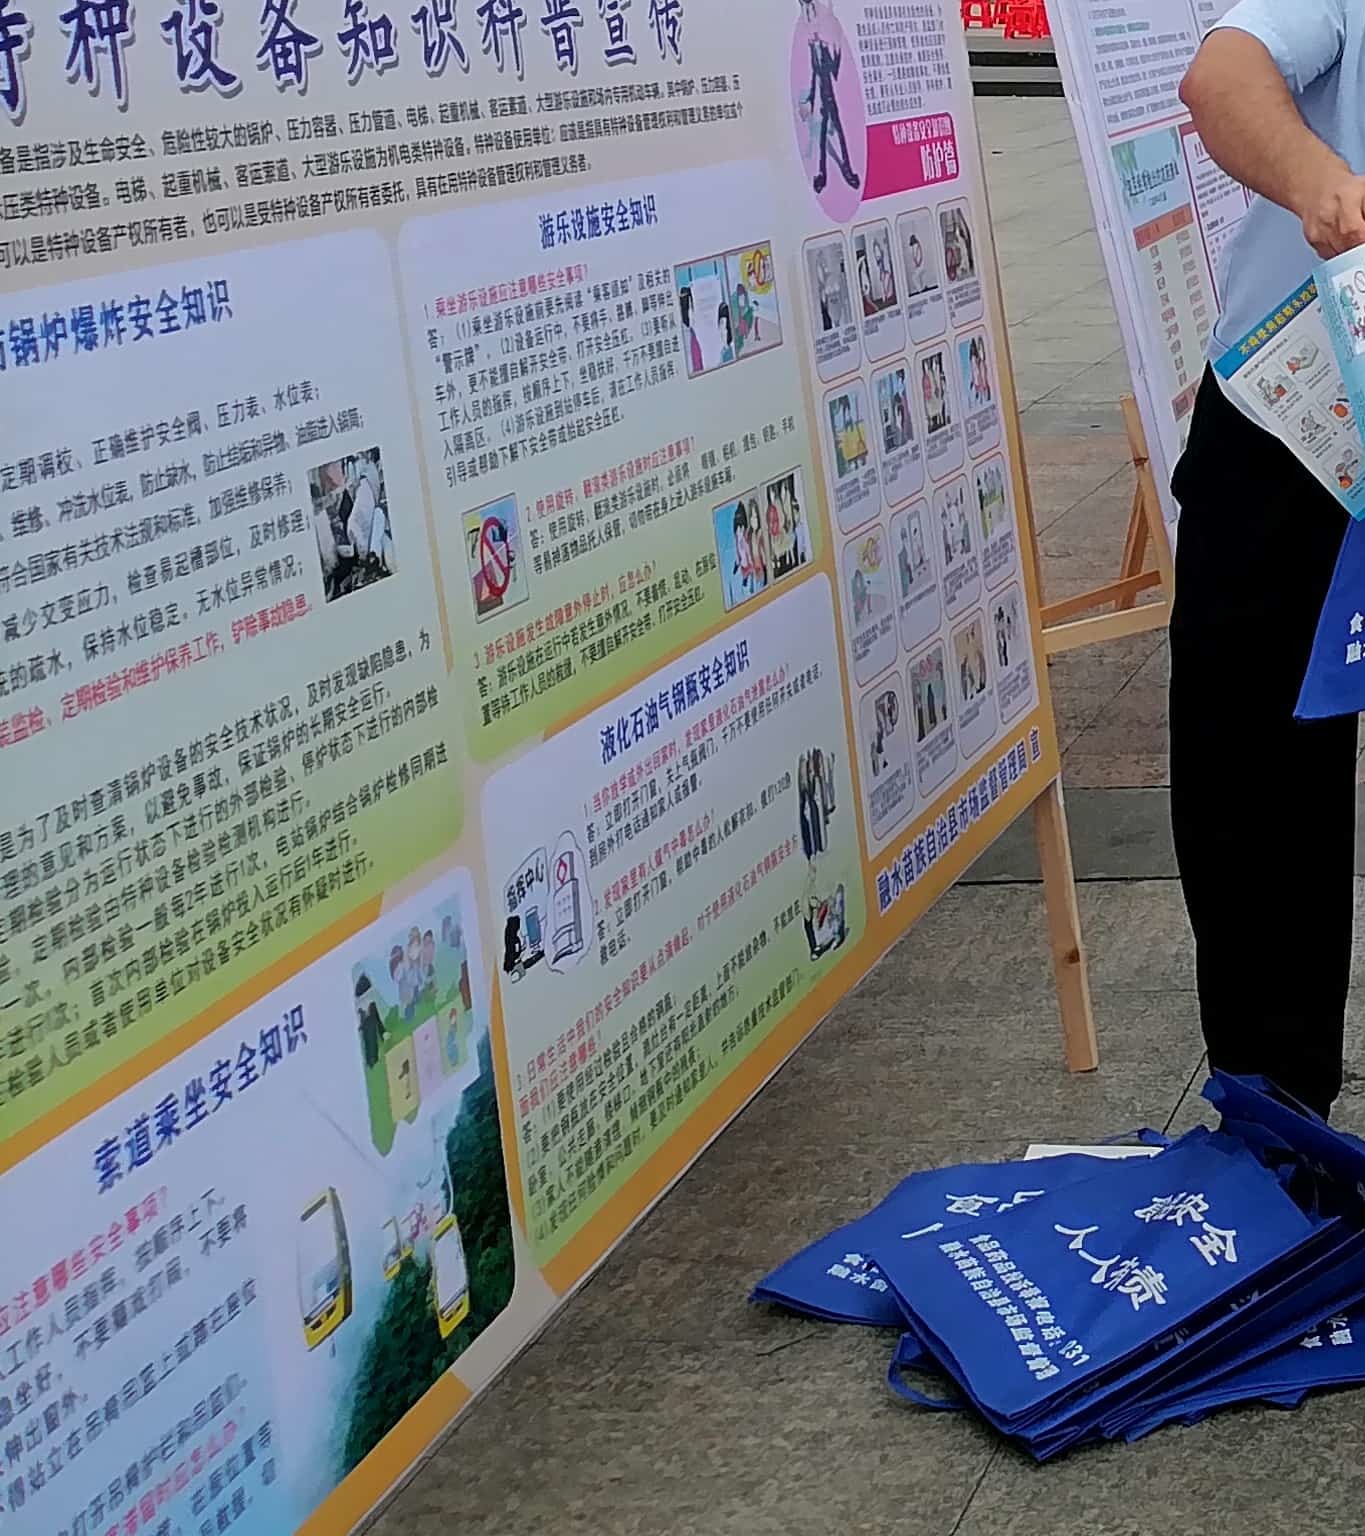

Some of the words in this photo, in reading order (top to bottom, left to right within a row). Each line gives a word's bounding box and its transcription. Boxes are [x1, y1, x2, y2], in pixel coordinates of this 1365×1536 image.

[538, 193, 658, 249] 游乐设施安全知识
[600, 638, 749, 765] 液化石油气钢瓶安全知识
[875, 739, 1029, 914] 融水苗族自治县市场监督管理局
[92, 1000, 308, 1199] 索道乘坐安全知识
